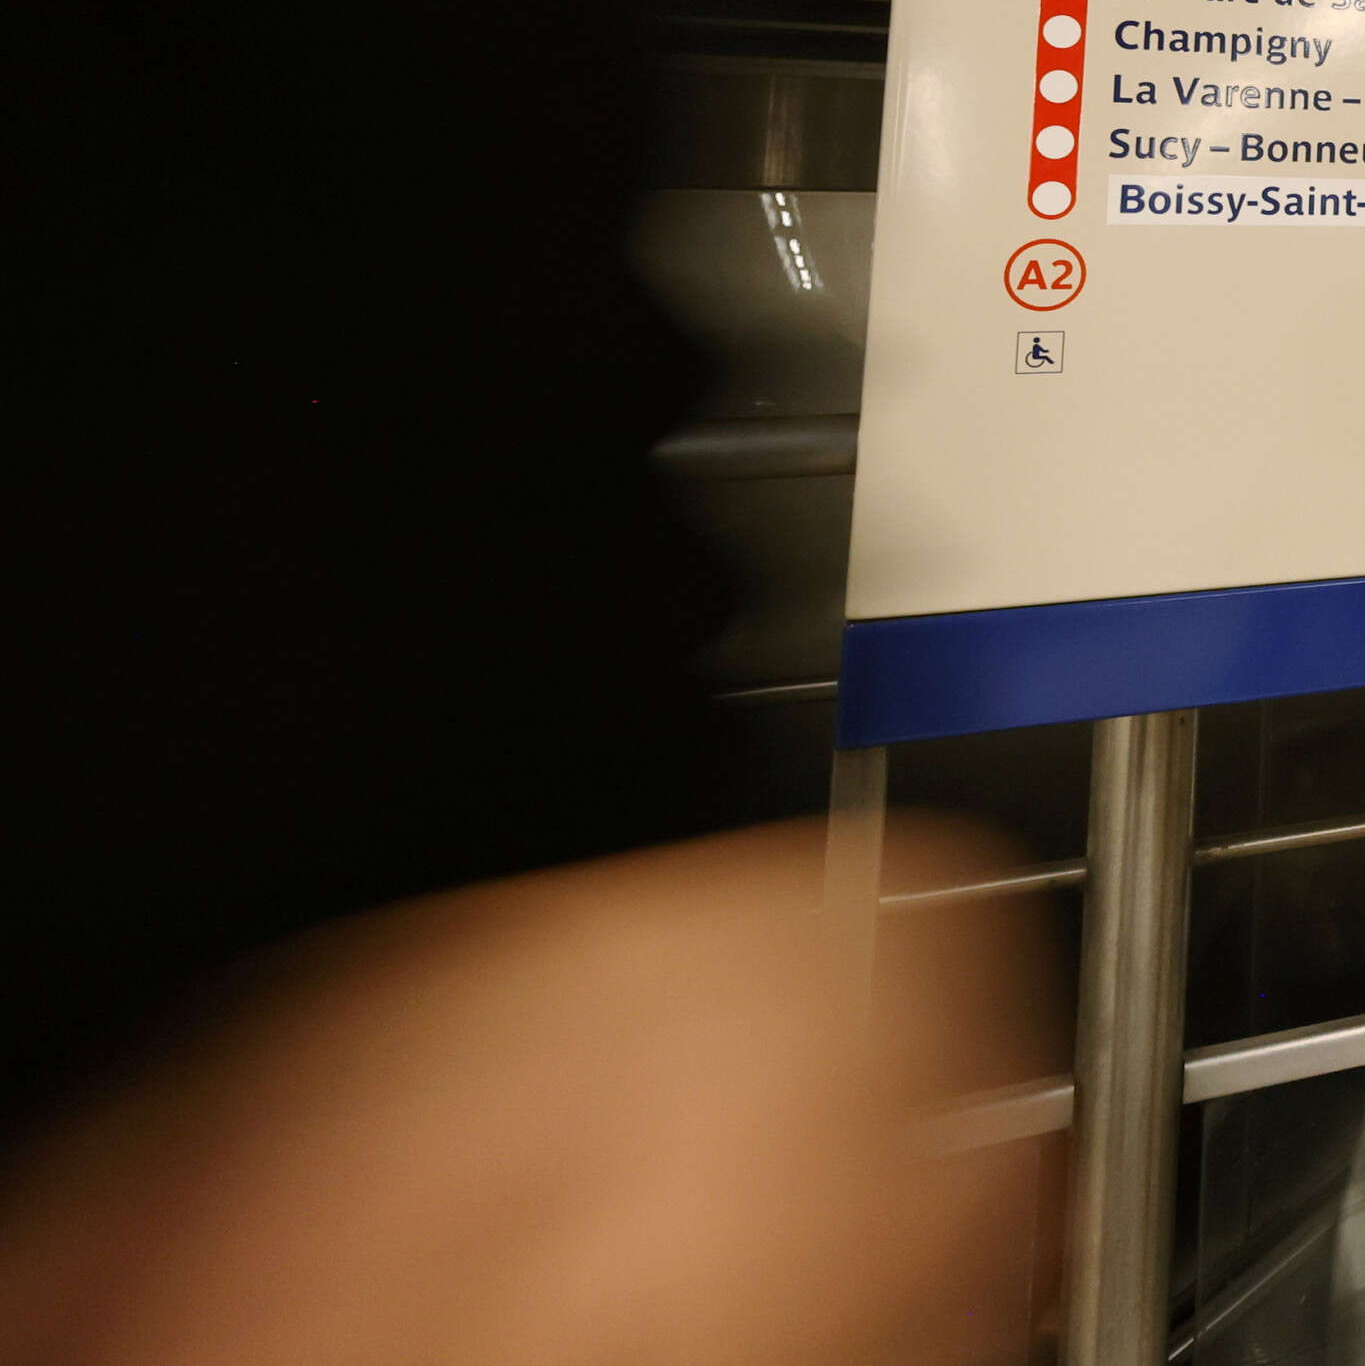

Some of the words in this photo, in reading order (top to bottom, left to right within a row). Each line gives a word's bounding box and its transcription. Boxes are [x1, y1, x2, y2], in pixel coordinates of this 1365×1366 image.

[1114, 20, 1332, 66] Champigny
[1113, 74, 1157, 105] La
[1172, 76, 1332, 112] Varenne
[1109, 128, 1201, 167] Sucy
[1017, 260, 1072, 290] A2
